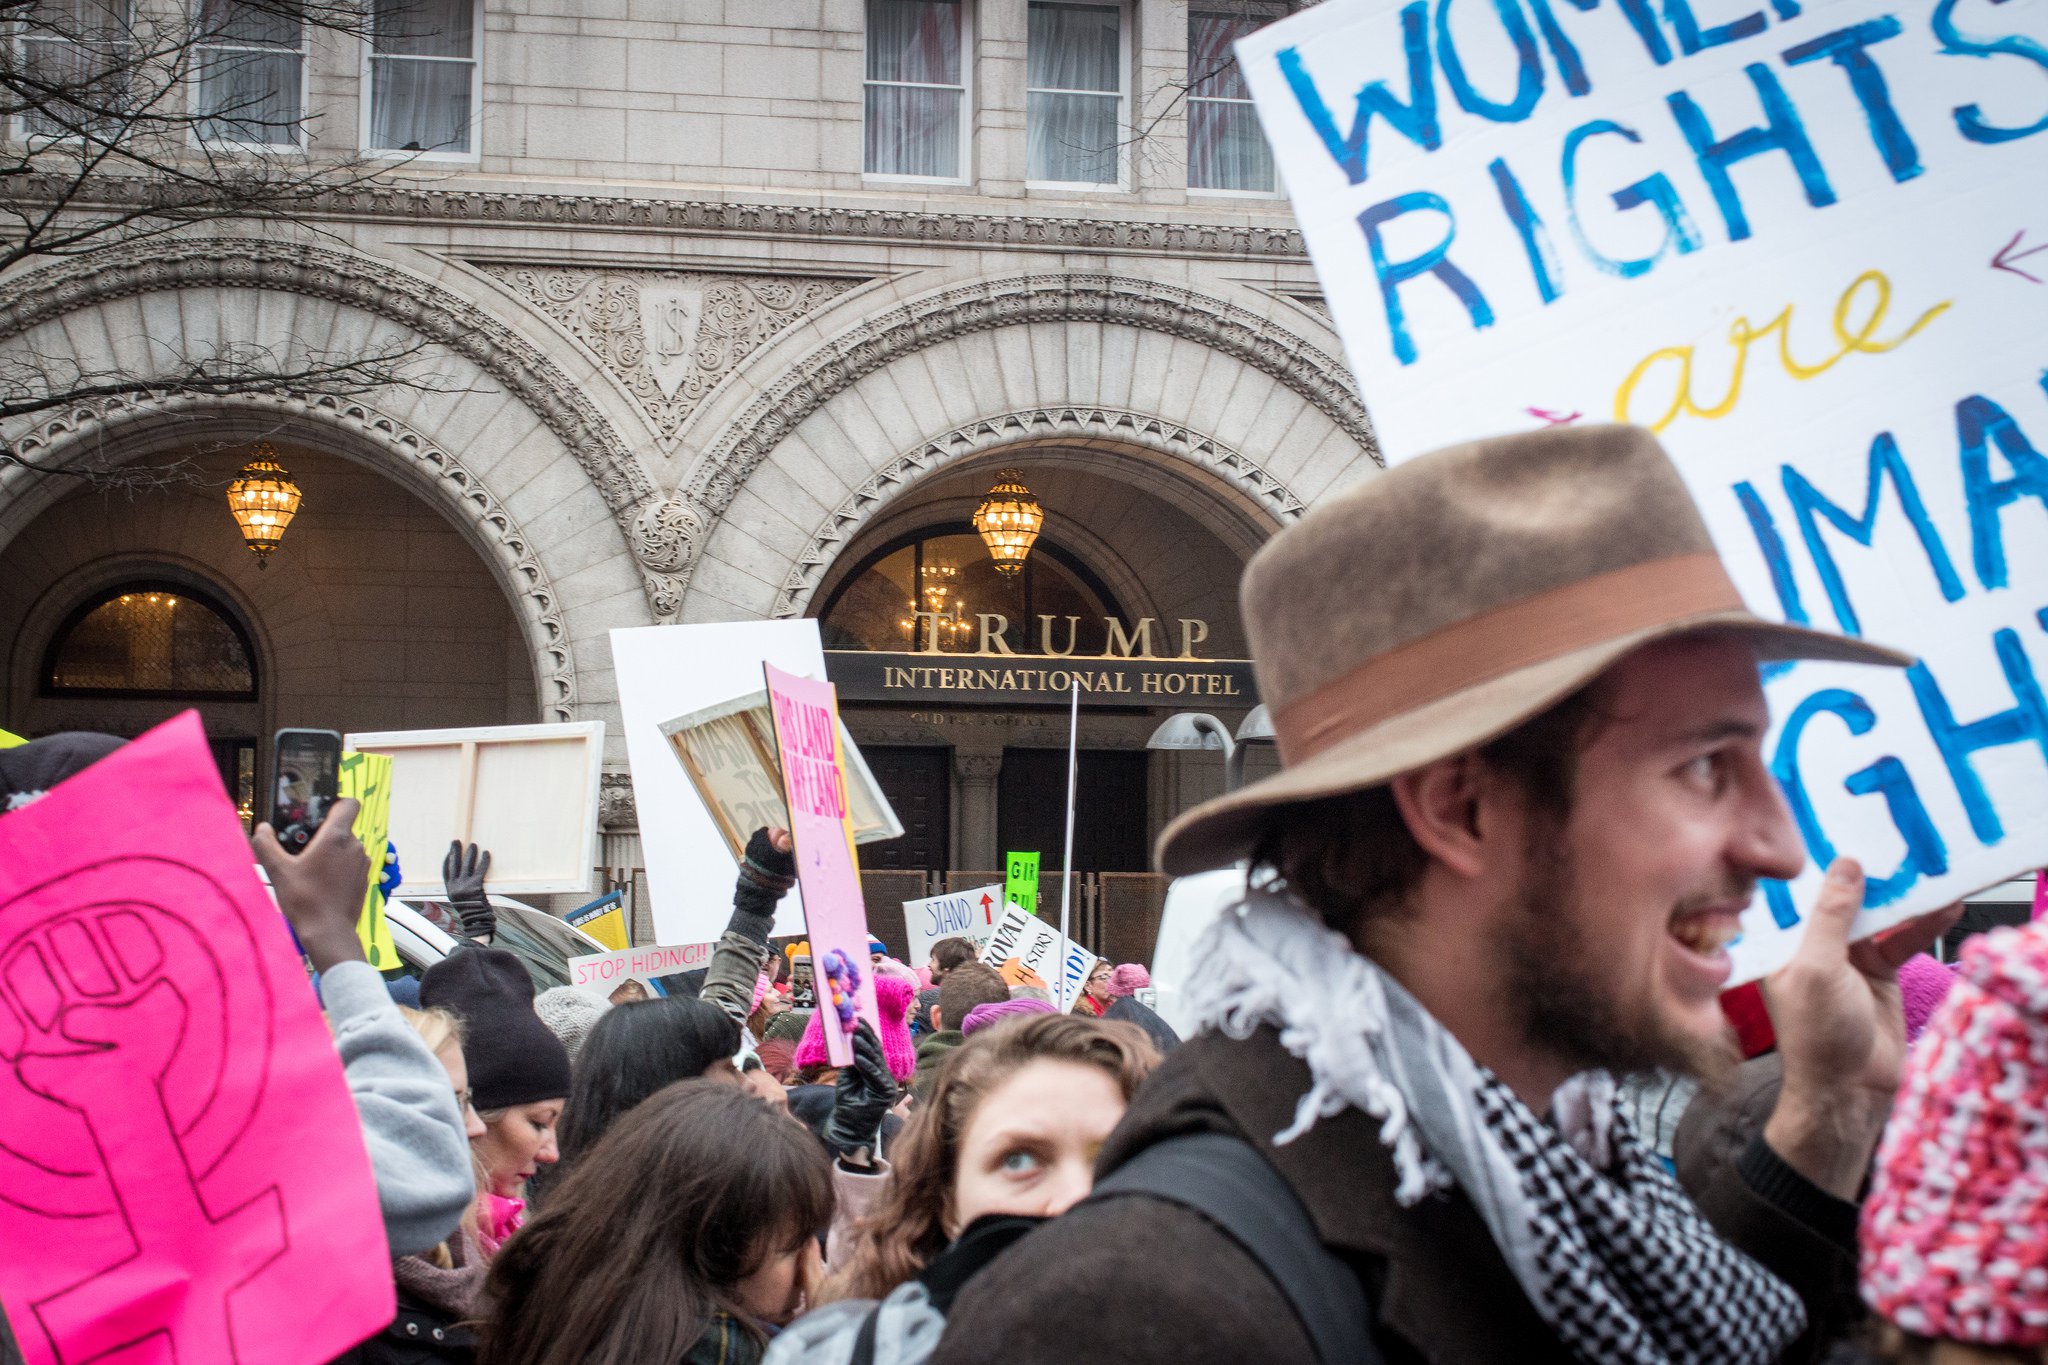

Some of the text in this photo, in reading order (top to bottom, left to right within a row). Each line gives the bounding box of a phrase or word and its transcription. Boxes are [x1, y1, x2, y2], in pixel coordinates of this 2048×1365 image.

[1357, 0, 2048, 366] RIGHTS
[1614, 270, 1953, 434] are
[913, 611, 1209, 659] TRUMP
[883, 666, 1240, 696] INTERNATIONAL HOTEL
[795, 701, 835, 762] LAND
[806, 760, 846, 819] LAND
[925, 898, 973, 936] STAND
[577, 943, 707, 985] STOP HIDING!!
[1014, 929, 1055, 985] HISTORY
[1053, 946, 1091, 1001] SAD!
